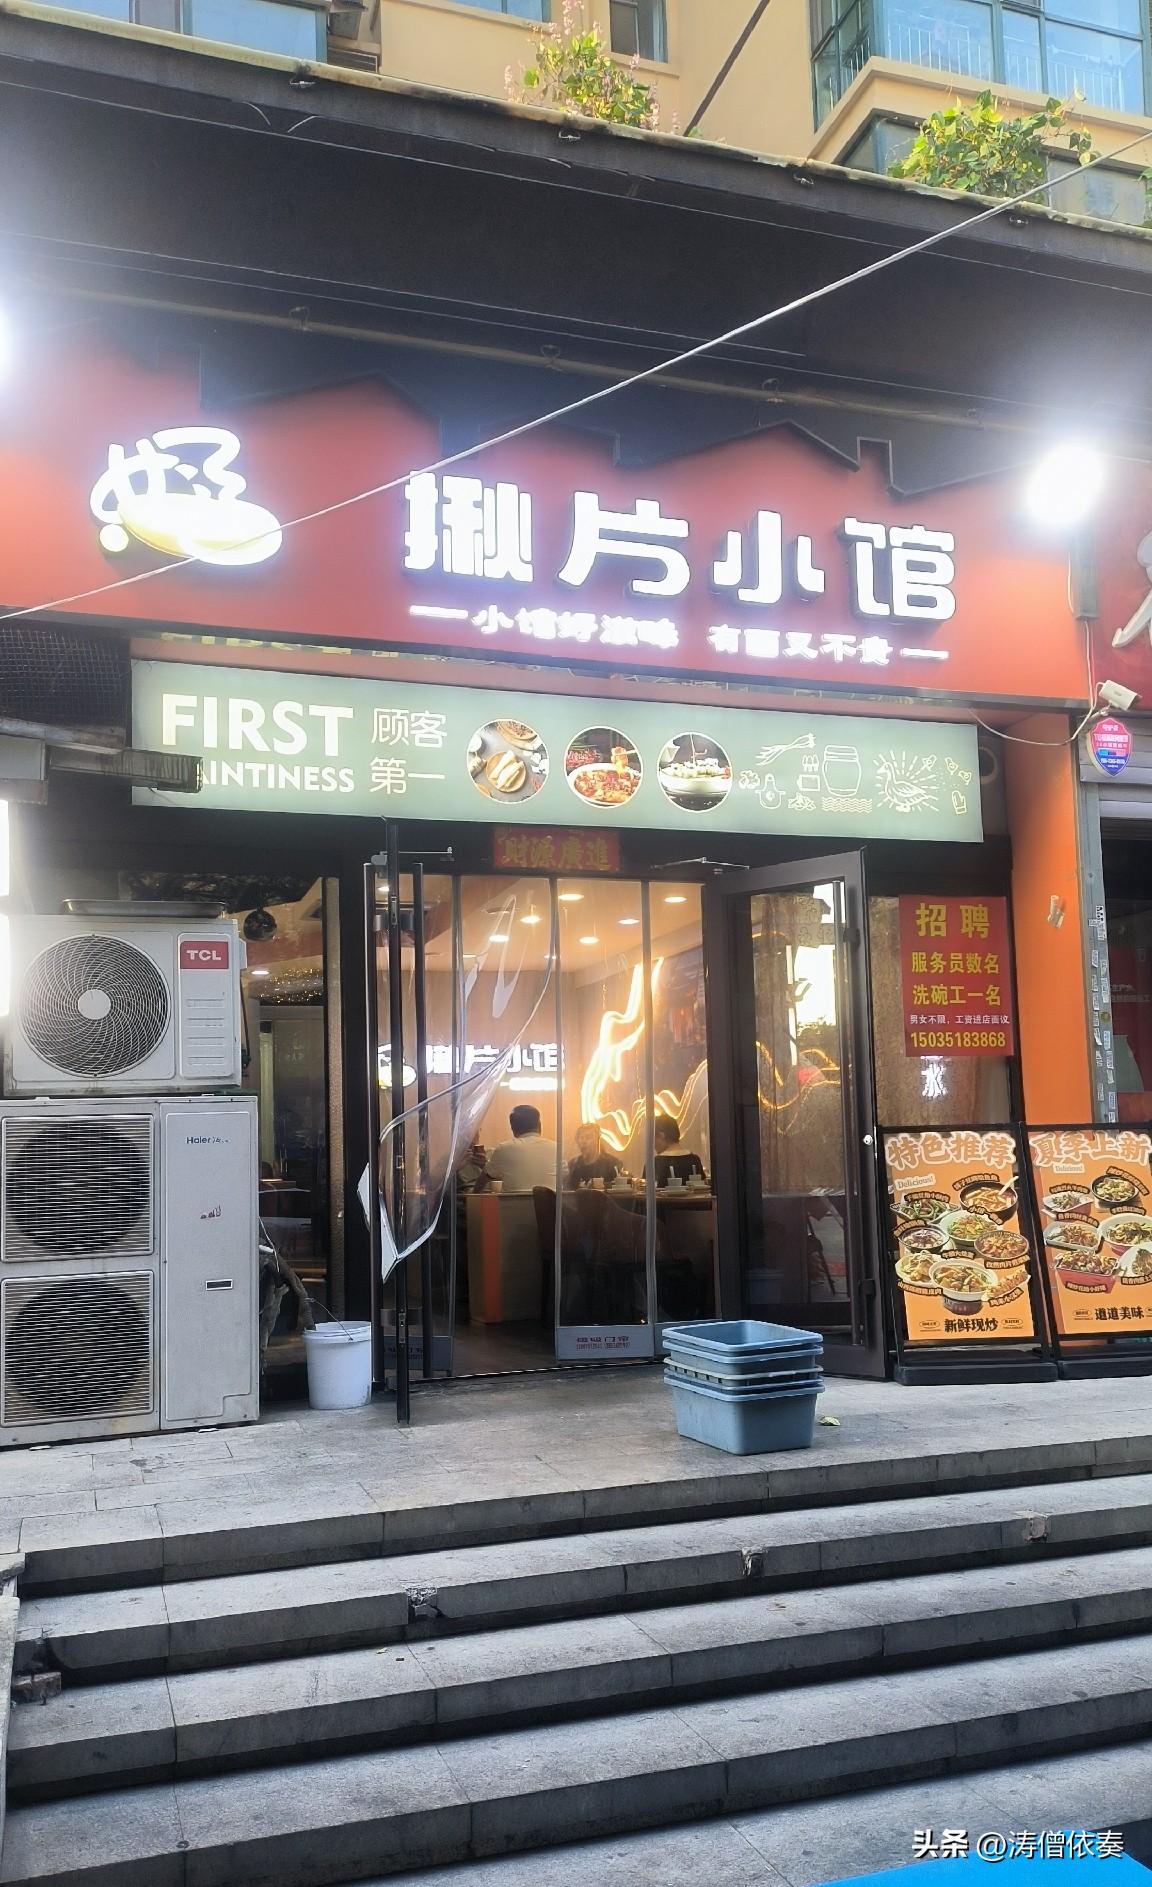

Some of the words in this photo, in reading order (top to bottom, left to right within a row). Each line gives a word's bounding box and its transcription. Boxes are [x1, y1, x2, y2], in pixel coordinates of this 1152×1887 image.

[404, 471, 956, 620] 揪片小馆
[162, 693, 353, 757] FIRST
[371, 707, 447, 748] 顾客
[369, 756, 446, 794] 第一
[916, 903, 990, 938] 招聘
[187, 950, 222, 961] TCL
[912, 952, 999, 974] 服务员数名
[913, 984, 1001, 1006] 洗碗工一名
[911, 1031, 1006, 1048] 15035183868
[186, 1136, 211, 1144] Haier
[885, 1131, 1016, 1171] 特色推荐
[1030, 1130, 1152, 1168] 夏季上新
[944, 1318, 999, 1333] 新鲜现炒
